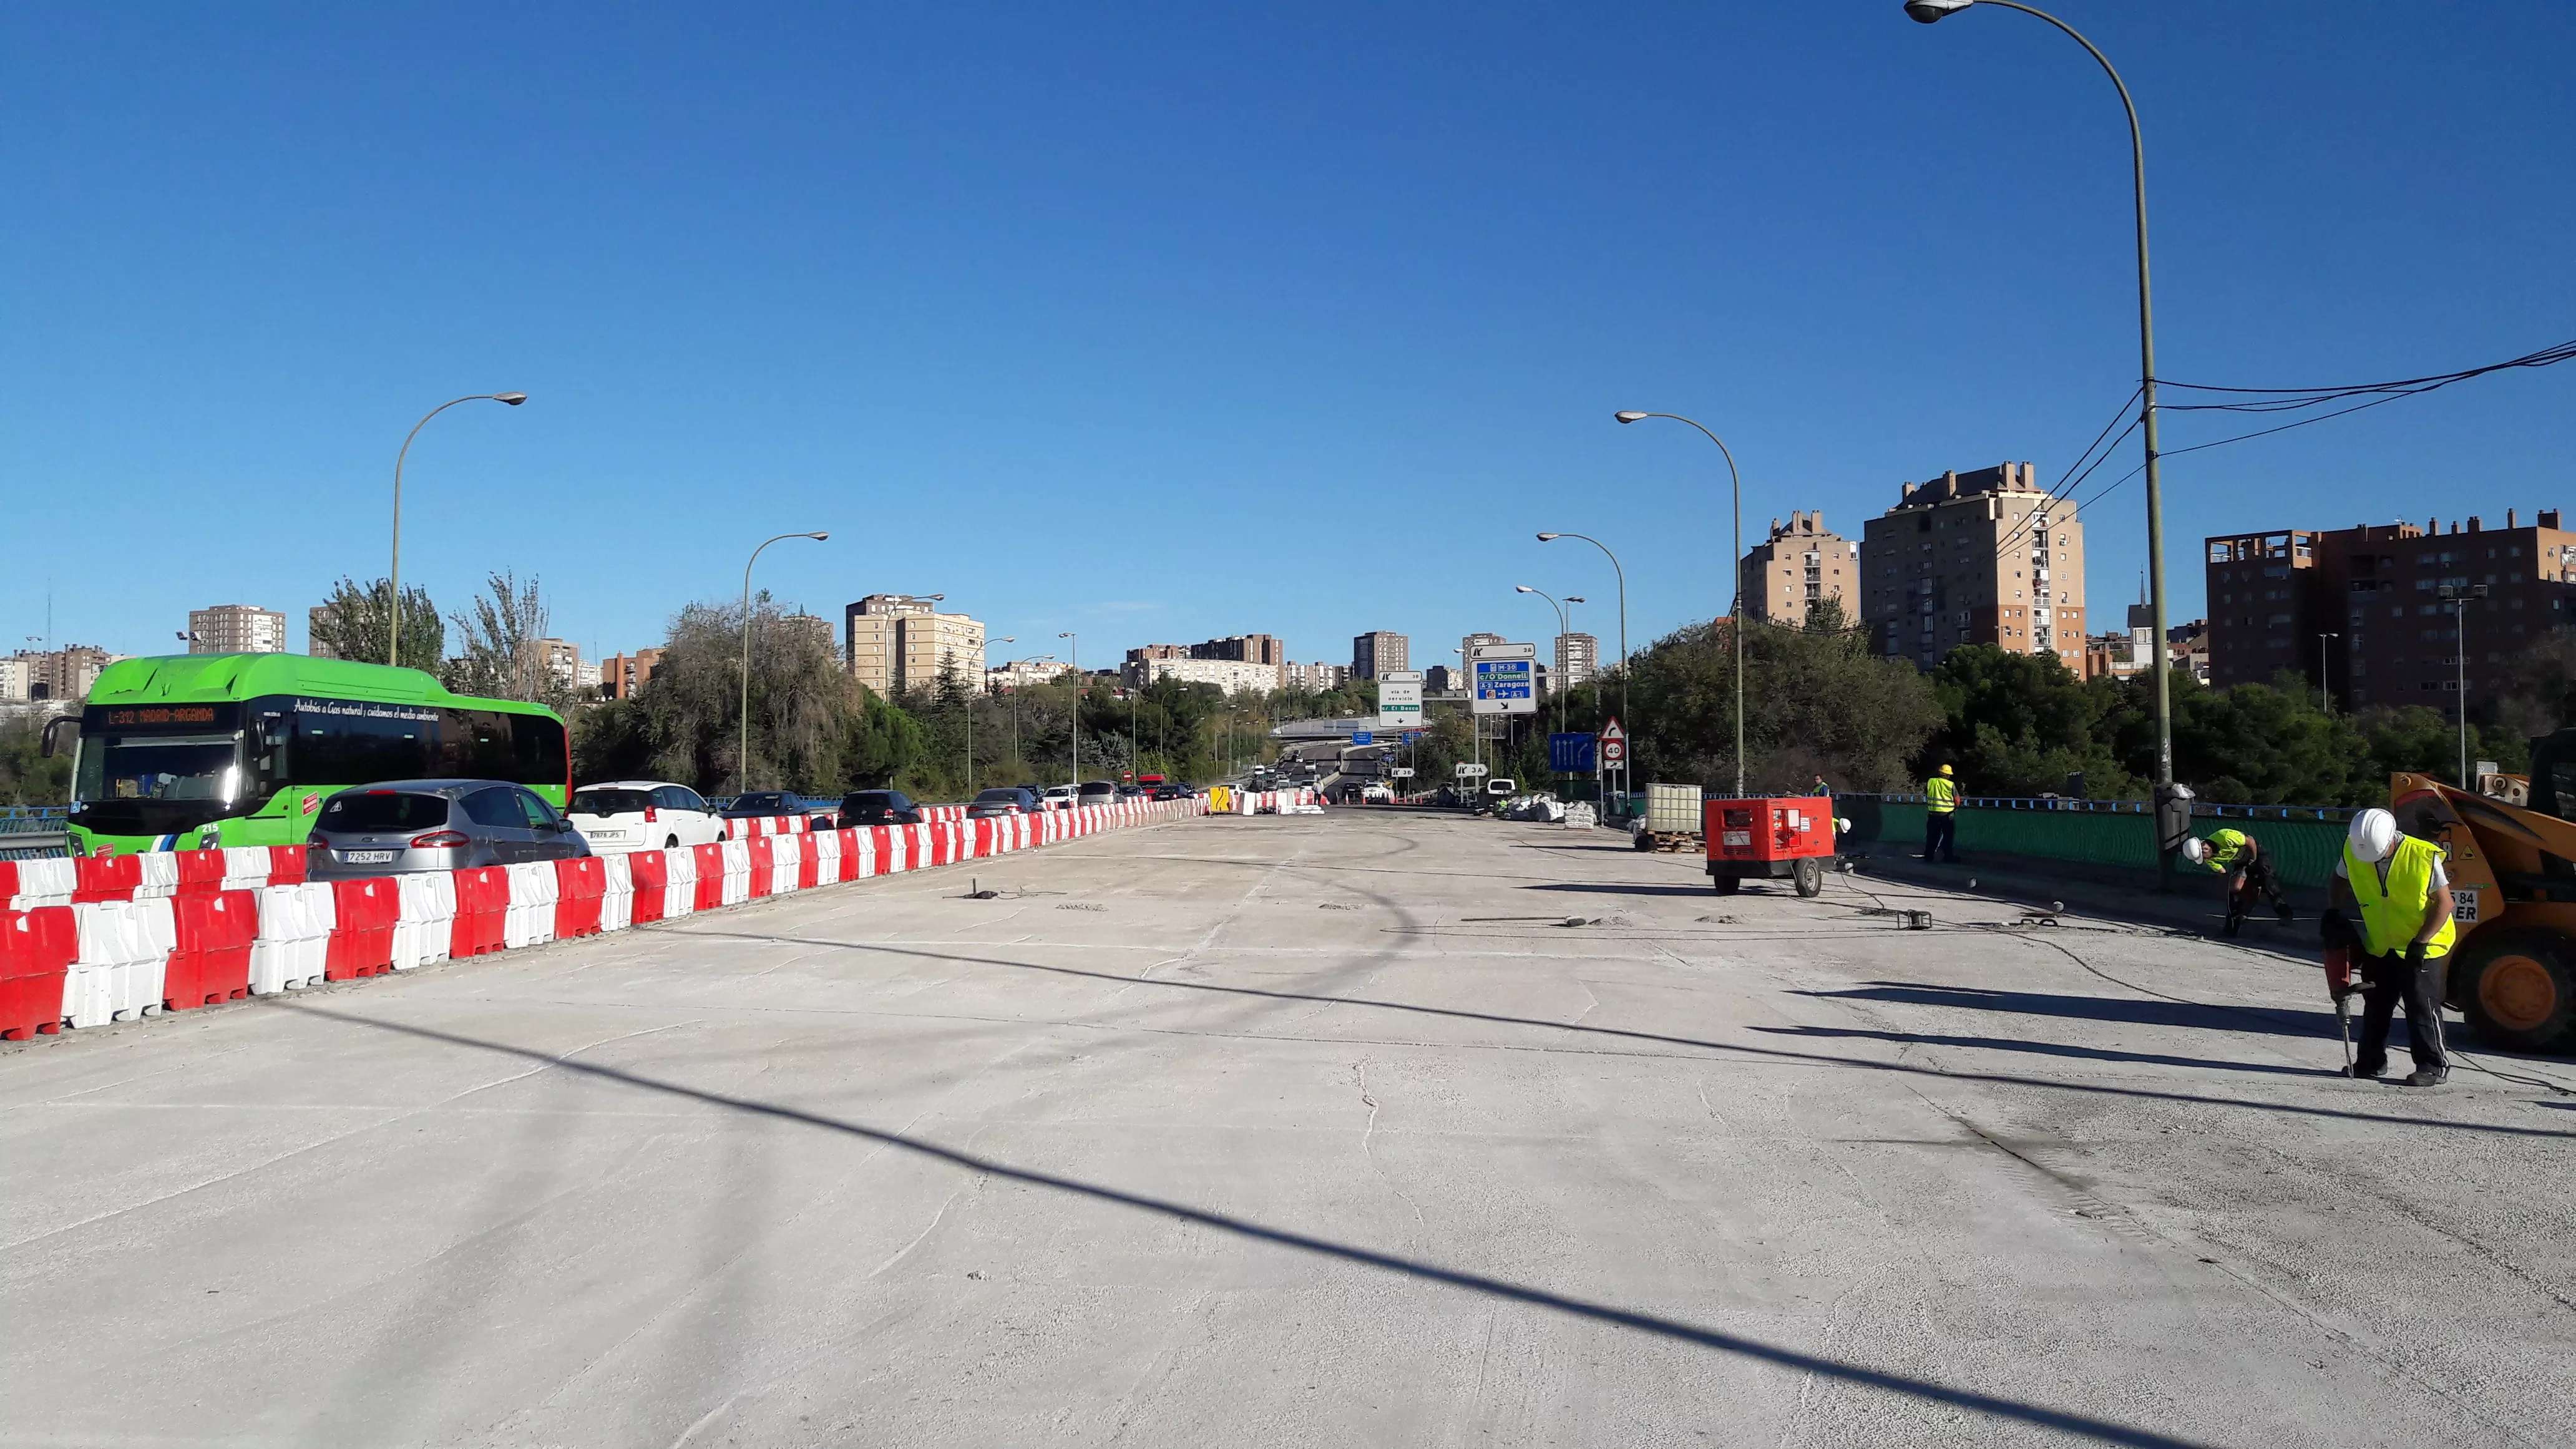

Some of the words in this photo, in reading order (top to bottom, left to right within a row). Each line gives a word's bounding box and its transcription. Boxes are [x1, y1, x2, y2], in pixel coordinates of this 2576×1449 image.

[202, 823, 218, 832] 215
[349, 852, 371, 861] 7252
[373, 852, 391, 861] HRV
[2459, 892, 2474, 904] 84
